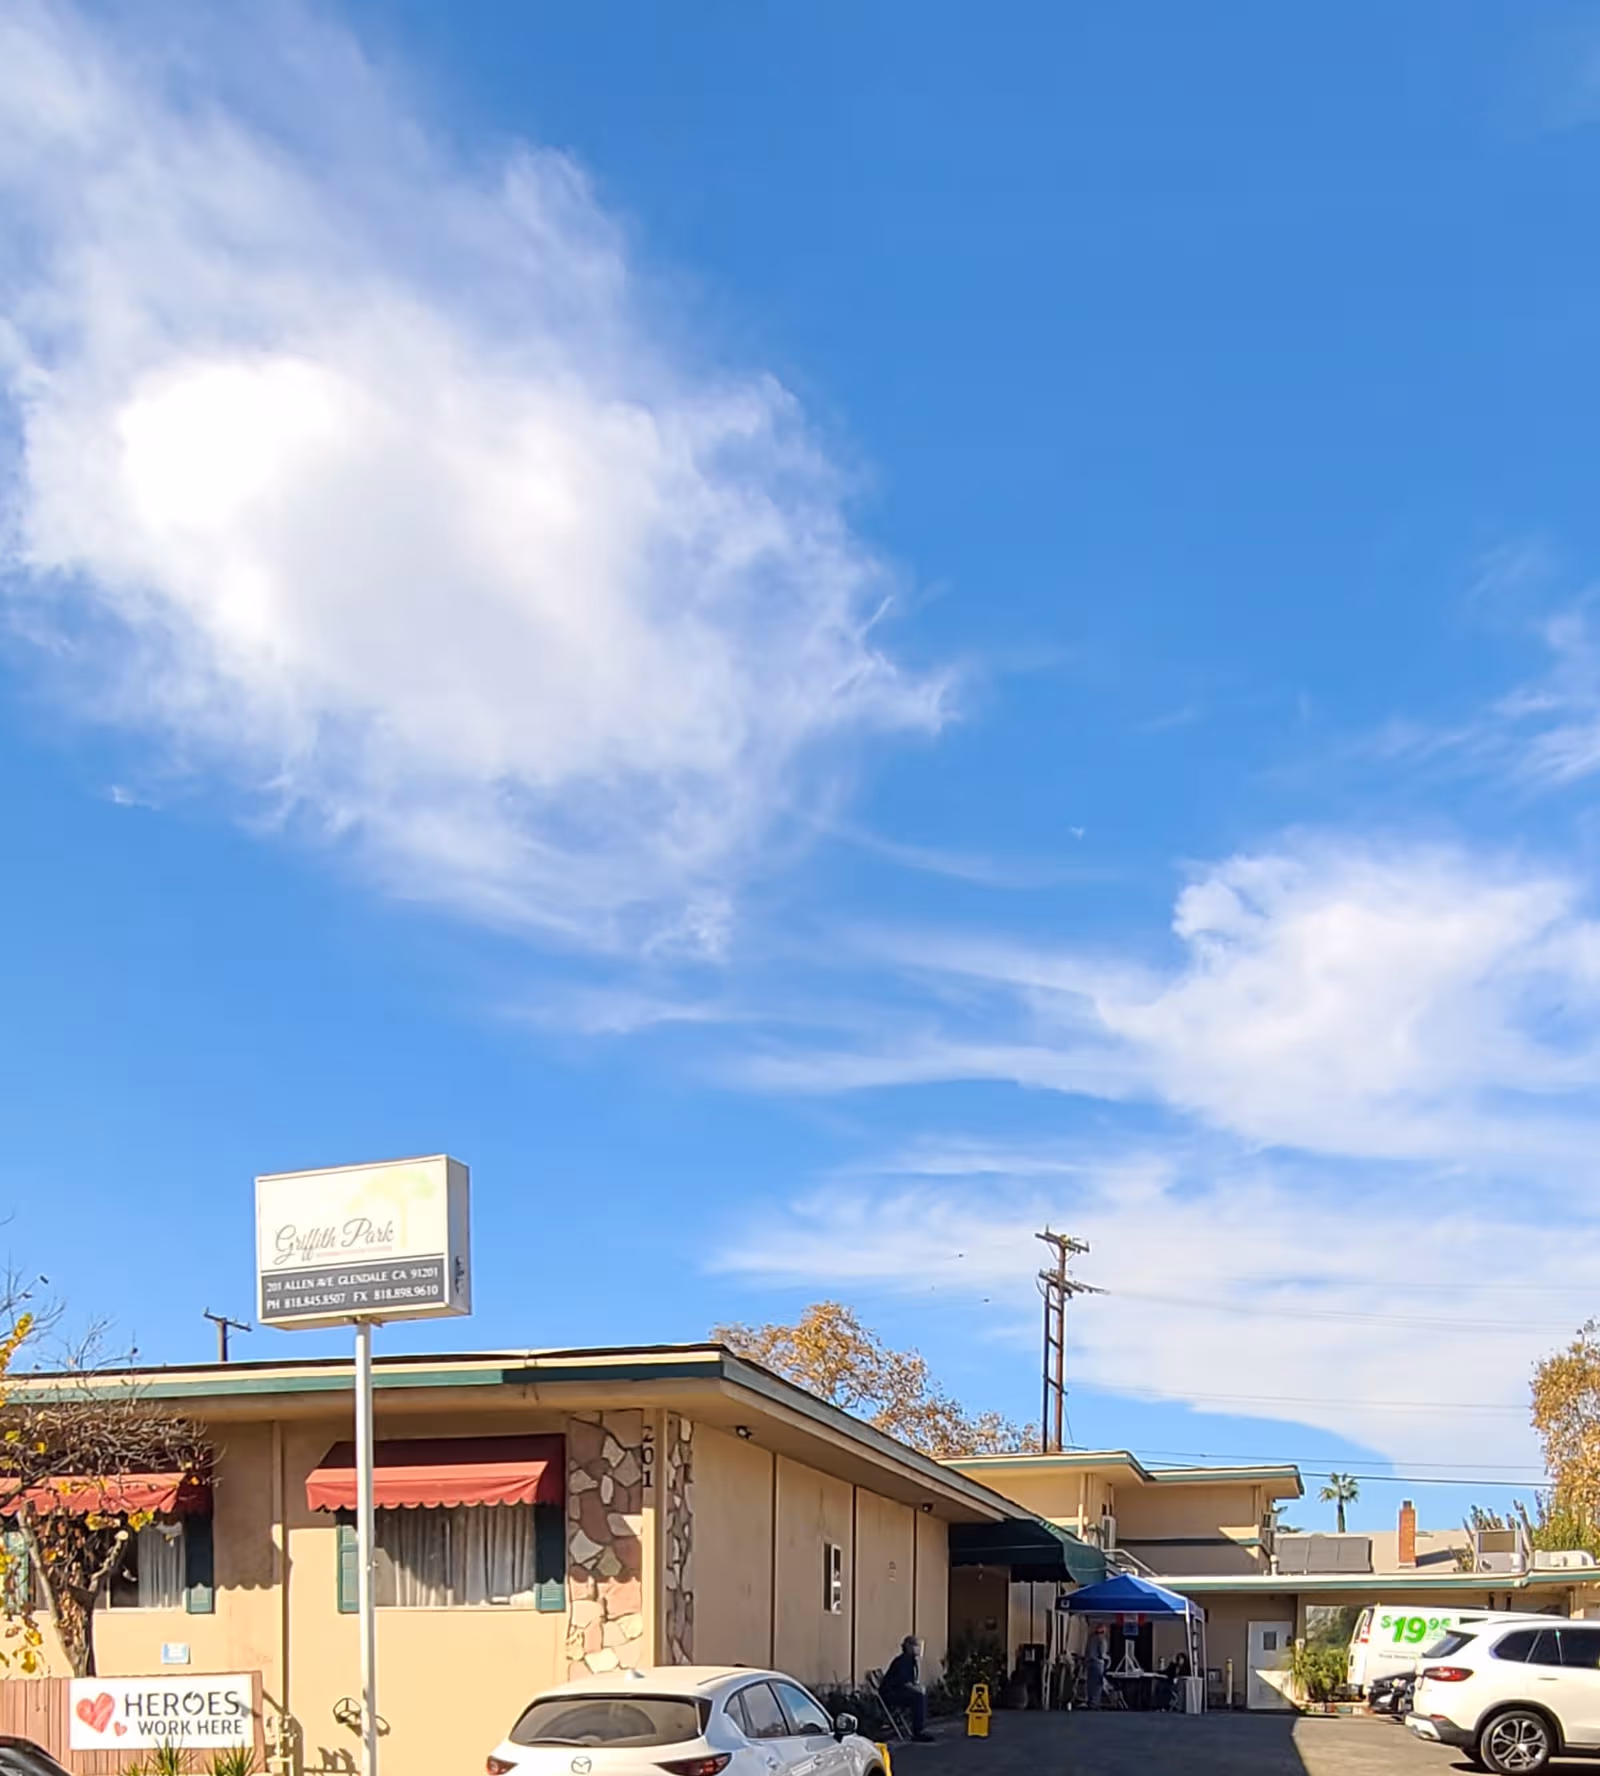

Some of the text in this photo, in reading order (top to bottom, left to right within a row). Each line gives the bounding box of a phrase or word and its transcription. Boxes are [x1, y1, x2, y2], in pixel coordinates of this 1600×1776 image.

[272, 1217, 394, 1265] Griffith Park
[284, 1278, 315, 1290] ALLEN
[316, 1276, 334, 1288] AVE
[338, 1271, 388, 1285] GLENDALE
[392, 1270, 407, 1281] CA
[410, 1267, 438, 1279] 91201
[266, 1299, 280, 1310] PH
[353, 1291, 368, 1303] FX
[124, 1690, 240, 1718] HEROES
[137, 1719, 243, 1736] WORK HERE
